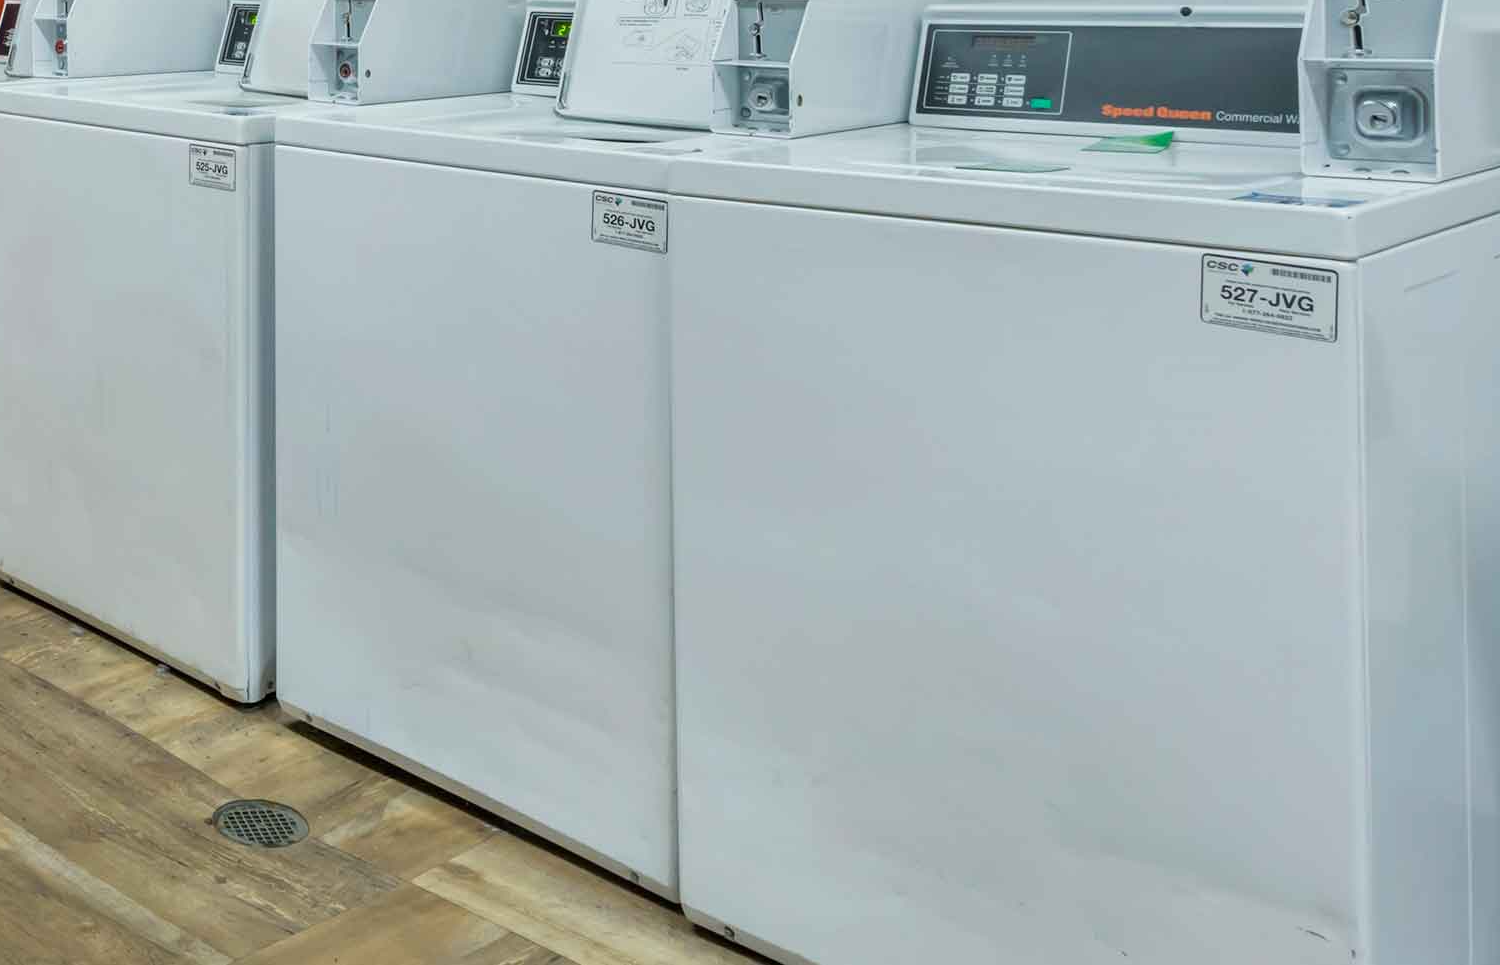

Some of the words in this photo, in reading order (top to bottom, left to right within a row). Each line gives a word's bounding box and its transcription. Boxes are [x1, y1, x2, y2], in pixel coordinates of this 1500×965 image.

[1102, 103, 1154, 118] Speed
[1157, 106, 1213, 121] Queen
[1216, 110, 1283, 124] Commercial
[595, 195, 614, 204] CSC
[603, 213, 655, 232] 526-JVG
[1206, 260, 1239, 272] CSC
[1220, 284, 1314, 312] 527-JVG
